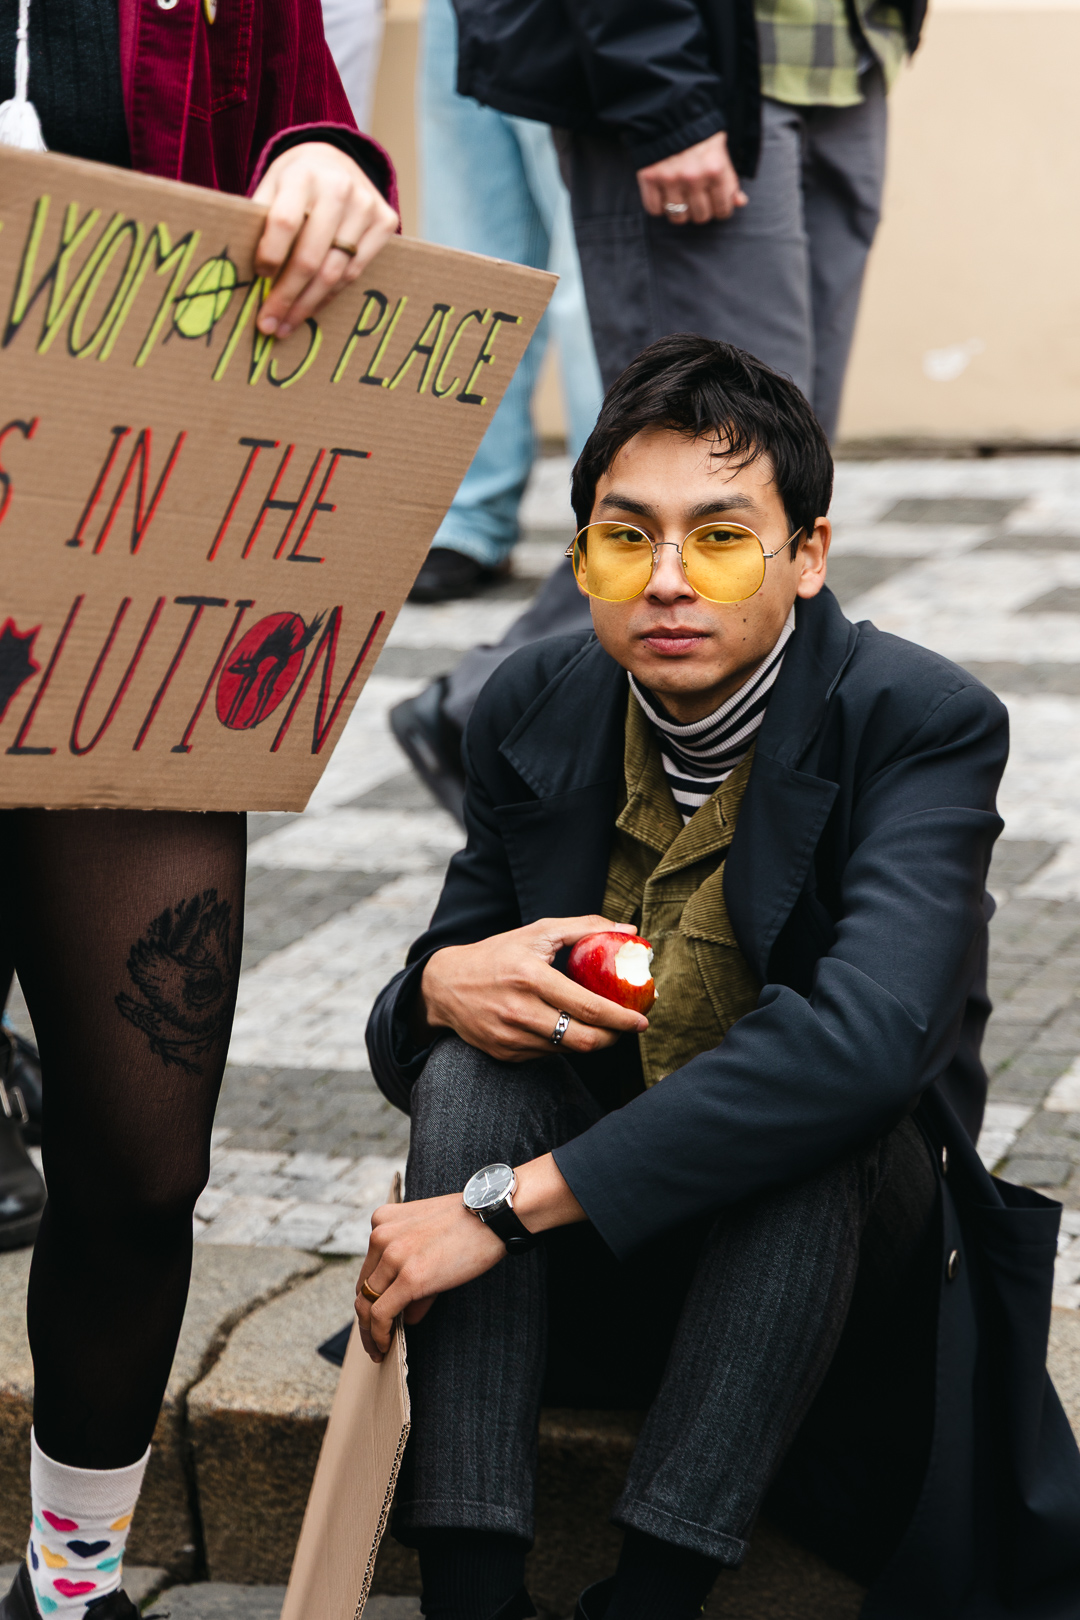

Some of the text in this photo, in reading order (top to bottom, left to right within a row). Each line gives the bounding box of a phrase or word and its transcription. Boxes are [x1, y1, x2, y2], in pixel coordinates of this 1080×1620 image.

[332, 289, 523, 405] PLACE
[66, 426, 187, 554] IN
[207, 438, 372, 563] THE
